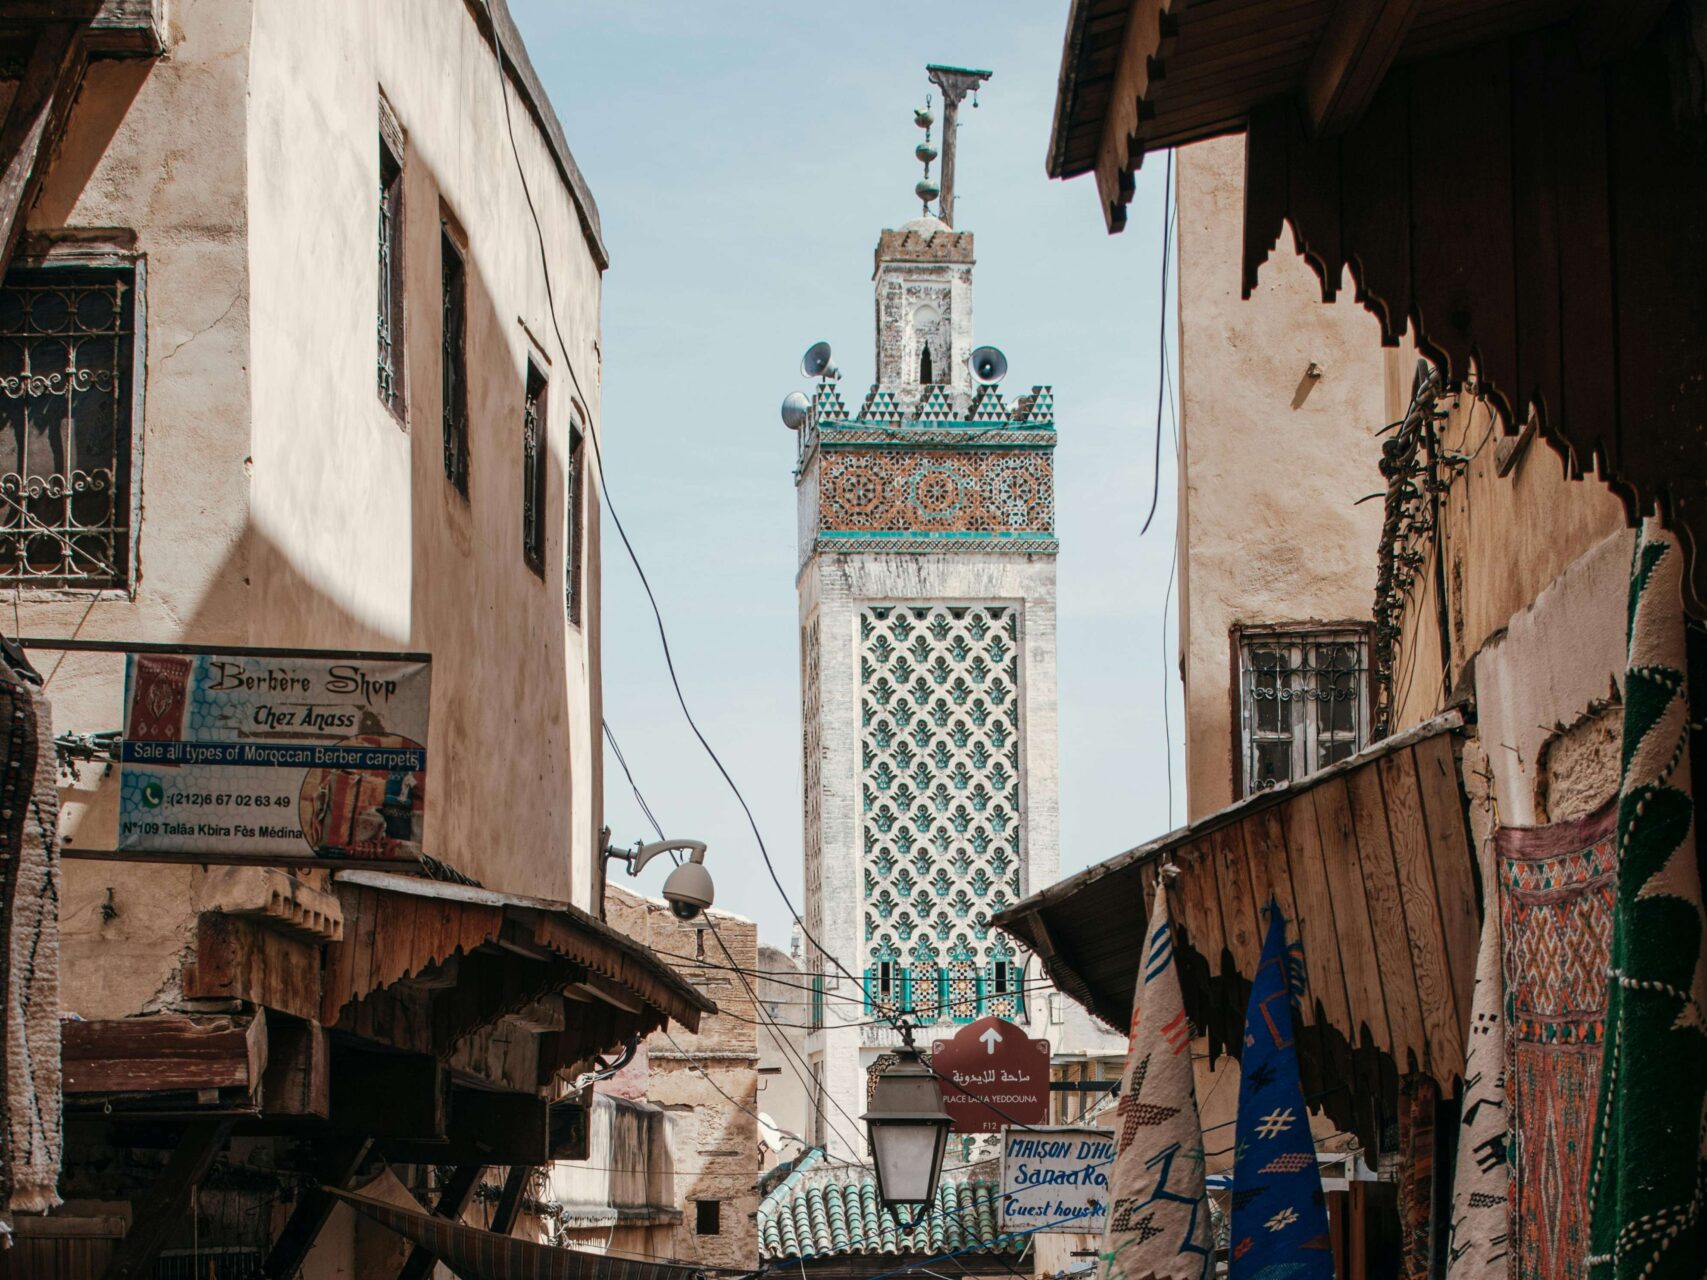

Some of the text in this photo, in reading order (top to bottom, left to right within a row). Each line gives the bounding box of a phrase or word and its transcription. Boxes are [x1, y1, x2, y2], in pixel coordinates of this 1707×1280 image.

[208, 660, 398, 706] Berbère Shop
[253, 705, 356, 731] Chez Anass
[134, 743, 164, 759] Sale
[167, 744, 182, 761] all
[186, 745, 223, 765] types
[226, 745, 241, 760] of
[244, 746, 312, 764] Moroccan
[315, 748, 361, 765] Berber
[216, 795, 232, 807] 67
[236, 795, 251, 807] 02
[255, 796, 271, 807] 63
[274, 796, 290, 808] 49
[162, 822, 195, 836] Talâa
[198, 823, 231, 837] Kbira
[233, 824, 256, 838] Fès
[258, 824, 303, 840] Médina
[1000, 1070, 1030, 1083] ساحة
[943, 1095, 966, 1103] PLACE
[992, 1095, 1037, 1103] YEDDOUNA
[983, 1122, 997, 1130] F12
[1008, 1138, 1072, 1160] MAISON
[1015, 1164, 1079, 1186] Sanaa
[1005, 1198, 1052, 1217] Guest
